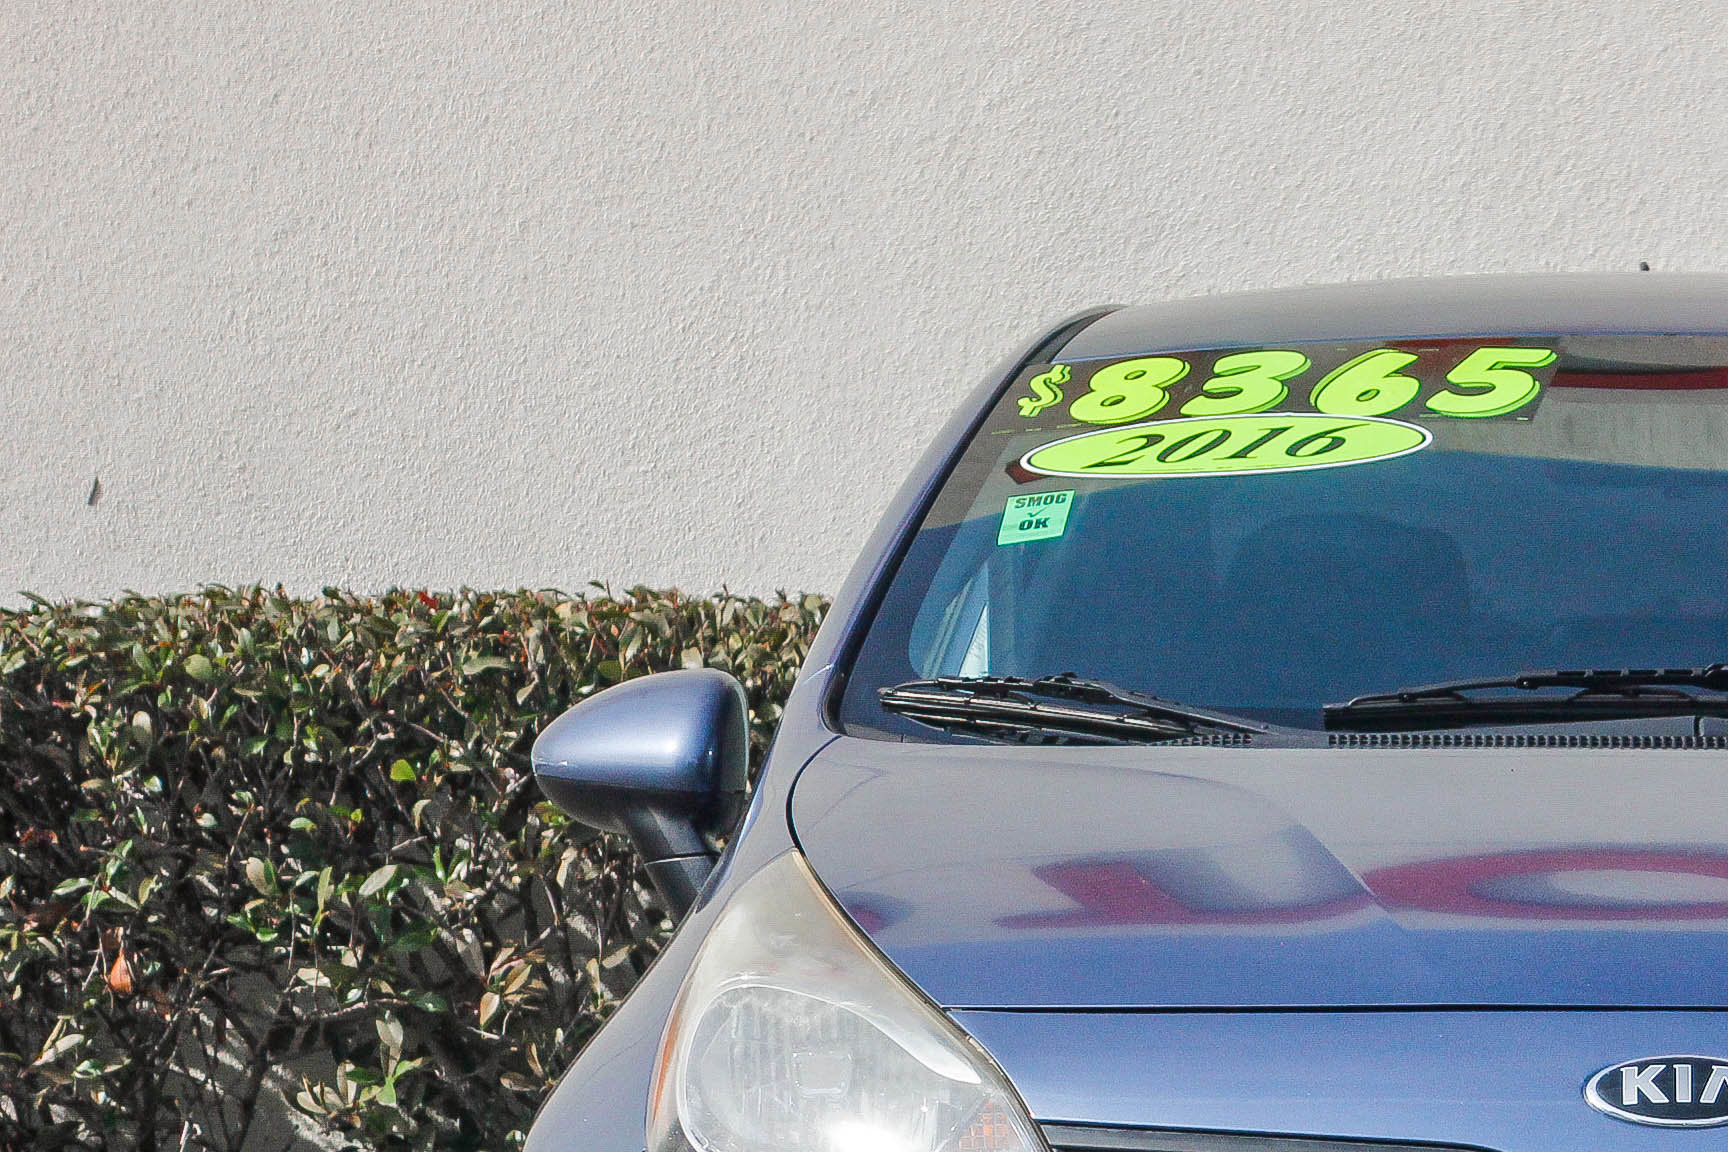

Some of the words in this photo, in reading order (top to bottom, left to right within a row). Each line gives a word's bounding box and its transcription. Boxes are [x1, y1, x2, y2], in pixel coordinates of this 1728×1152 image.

[1017, 346, 1559, 425] $8365
[1081, 422, 1372, 470] 2016
[1014, 493, 1068, 509] SMOG
[1018, 517, 1051, 531] OK
